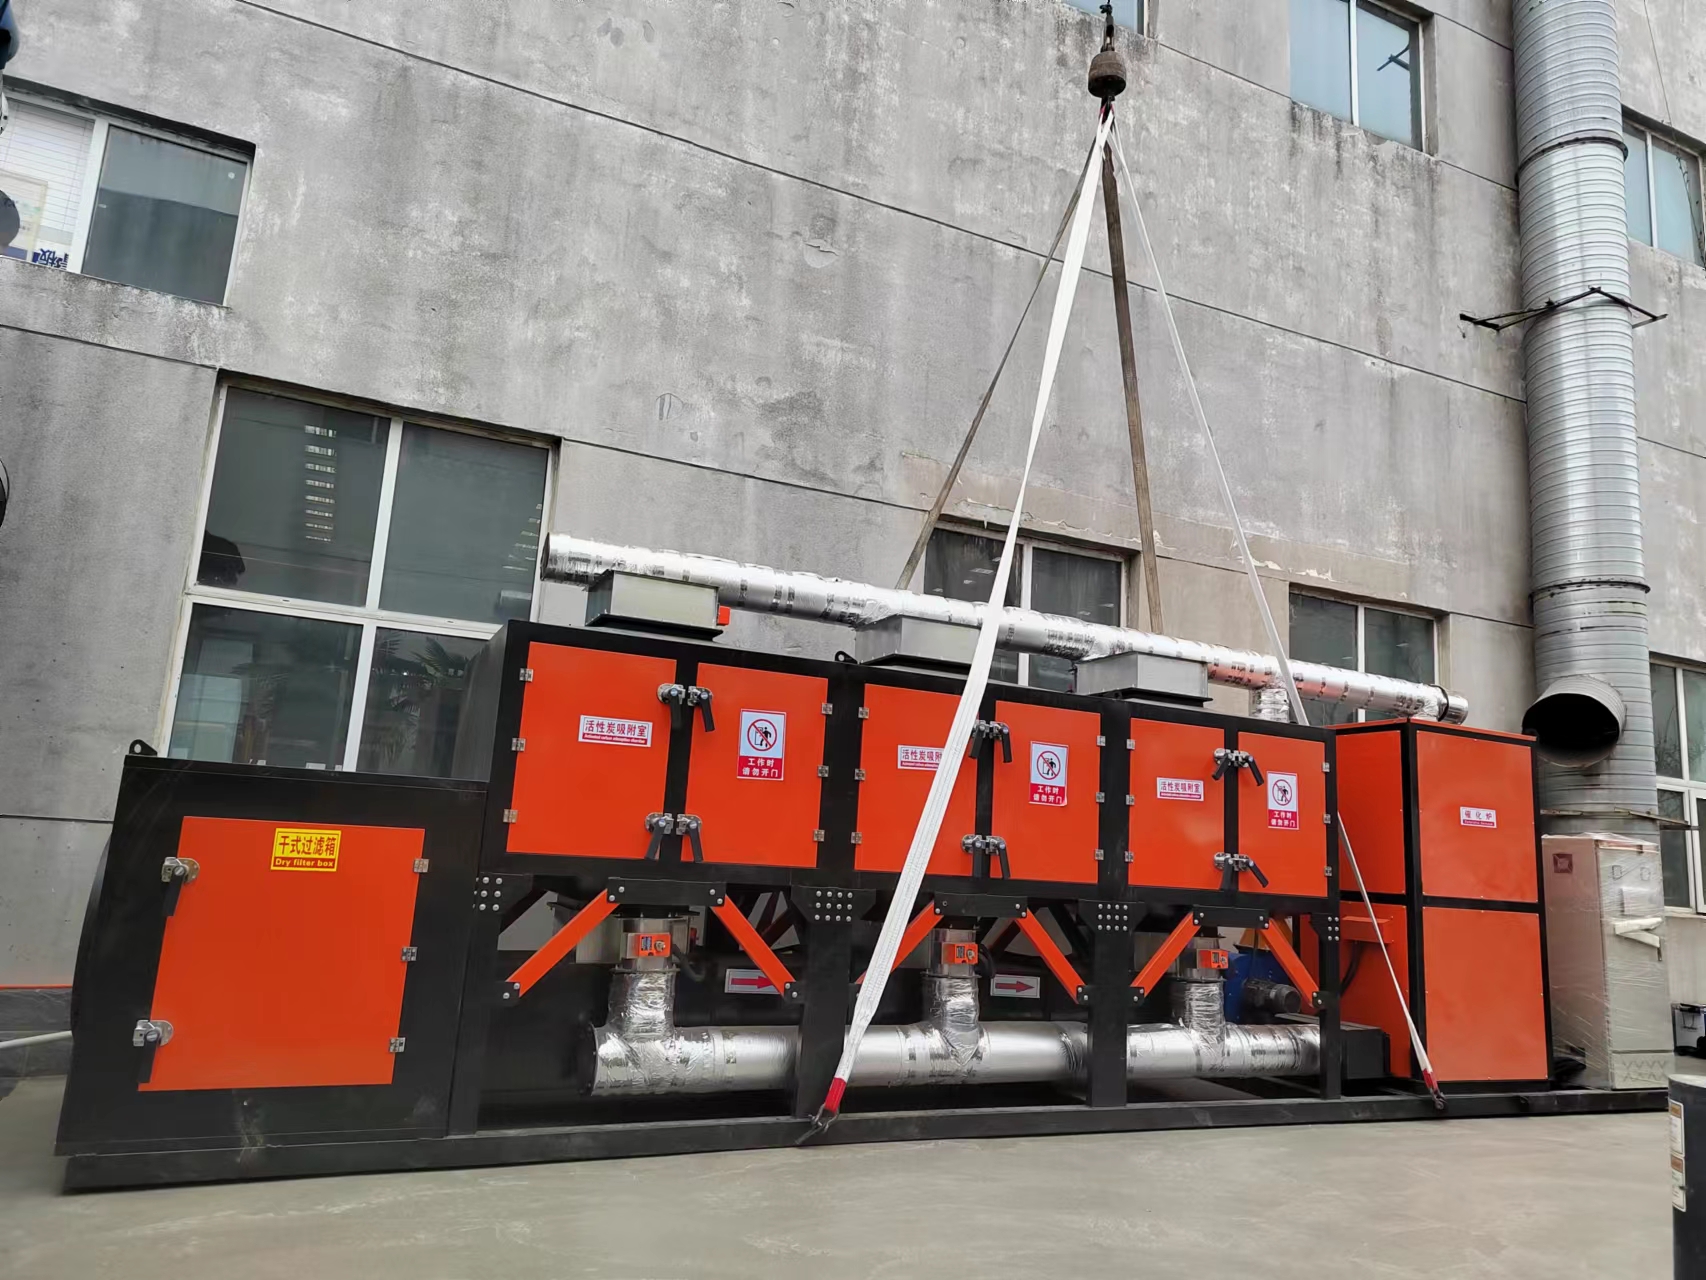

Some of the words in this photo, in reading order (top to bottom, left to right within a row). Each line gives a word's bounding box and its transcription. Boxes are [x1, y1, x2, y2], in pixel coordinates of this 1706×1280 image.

[584, 719, 647, 737] 活性炭吸附室
[747, 757, 775, 767] 工作时
[742, 767, 779, 777] 请勿开门
[278, 835, 337, 856] 干式过滤箱
[275, 858, 291, 867] Dry
[293, 858, 316, 867] filter
